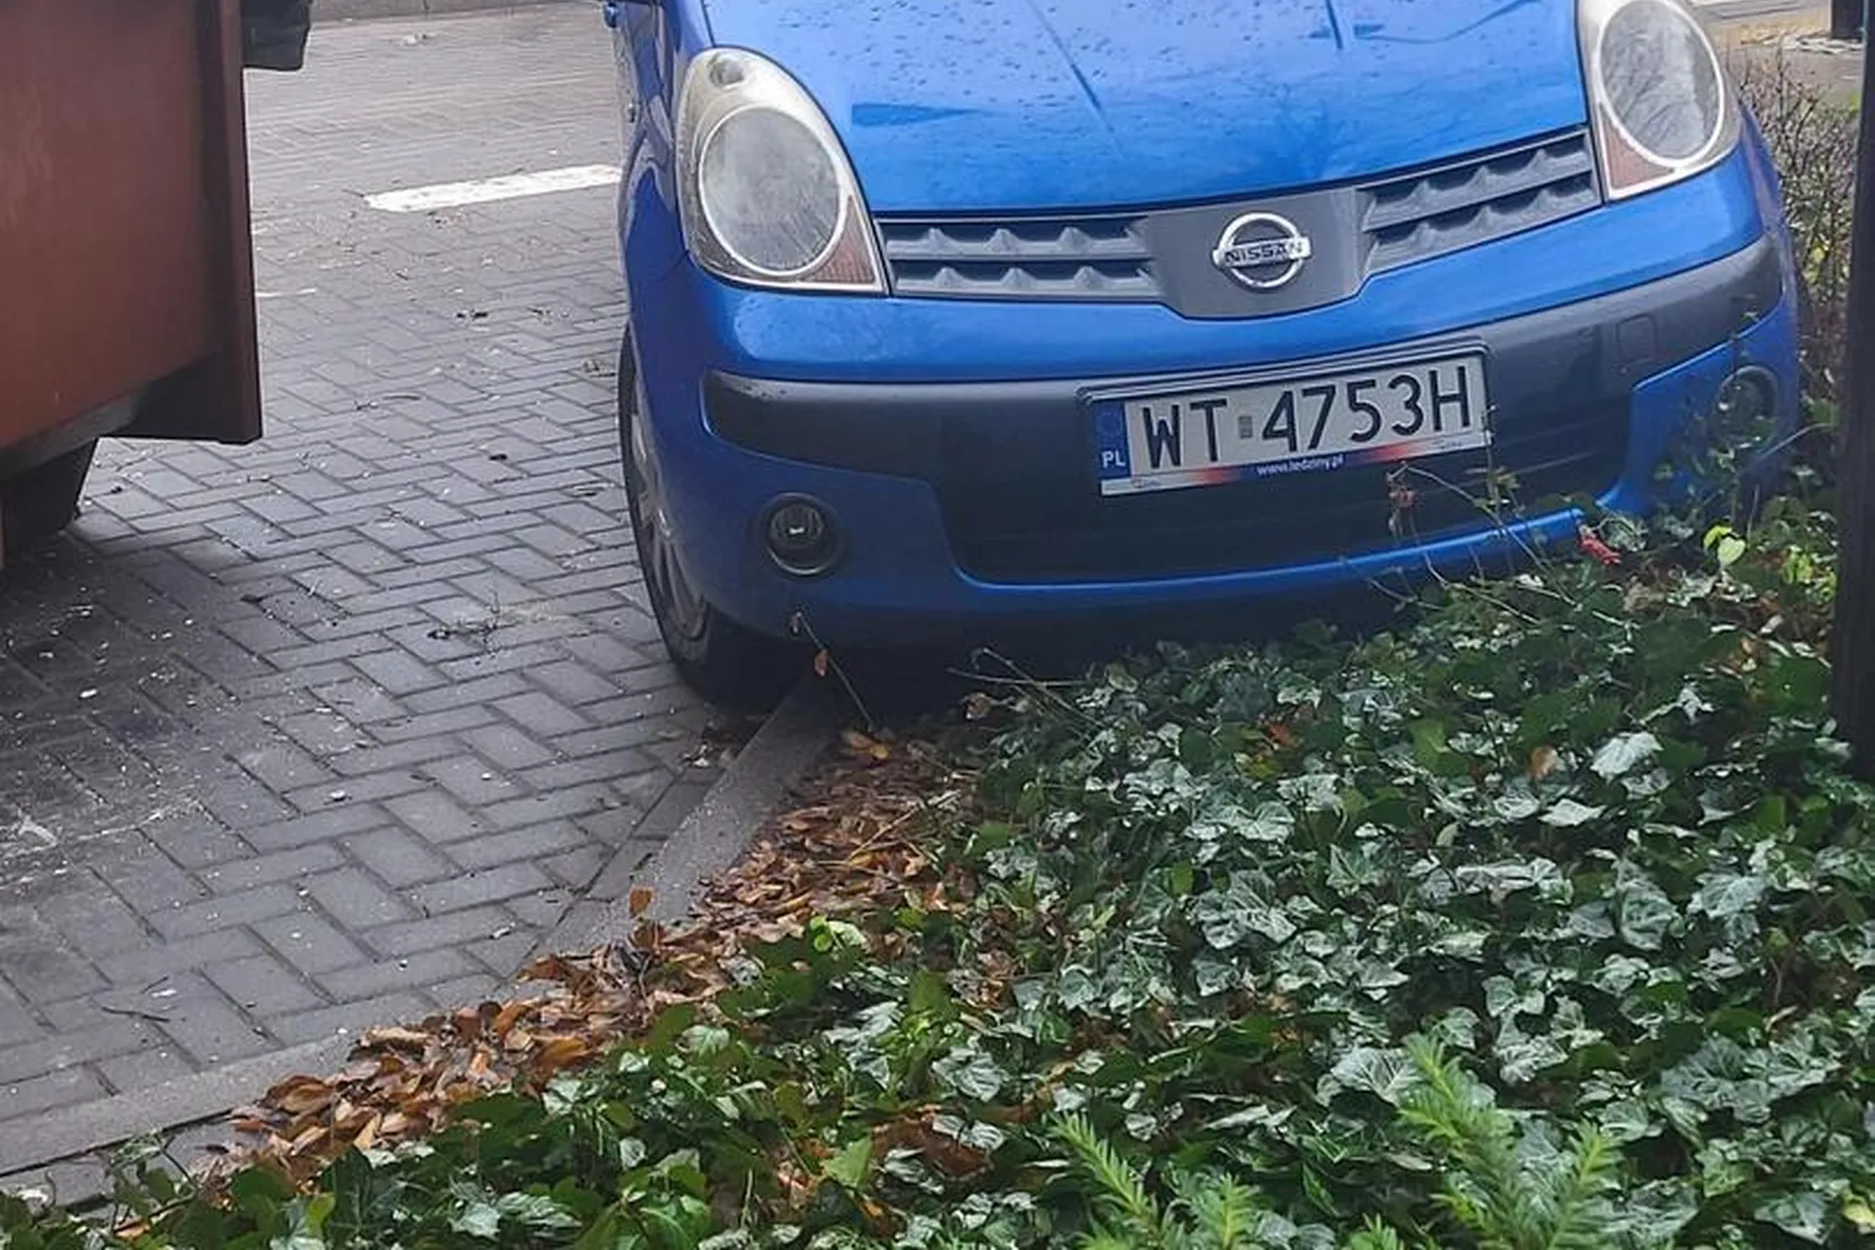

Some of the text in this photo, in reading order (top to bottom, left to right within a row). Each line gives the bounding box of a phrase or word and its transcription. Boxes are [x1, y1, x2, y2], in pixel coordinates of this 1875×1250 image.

[1224, 239, 1304, 264] NISSAN
[1143, 366, 1471, 469] WT 4753H
[1102, 450, 1127, 469] PL
